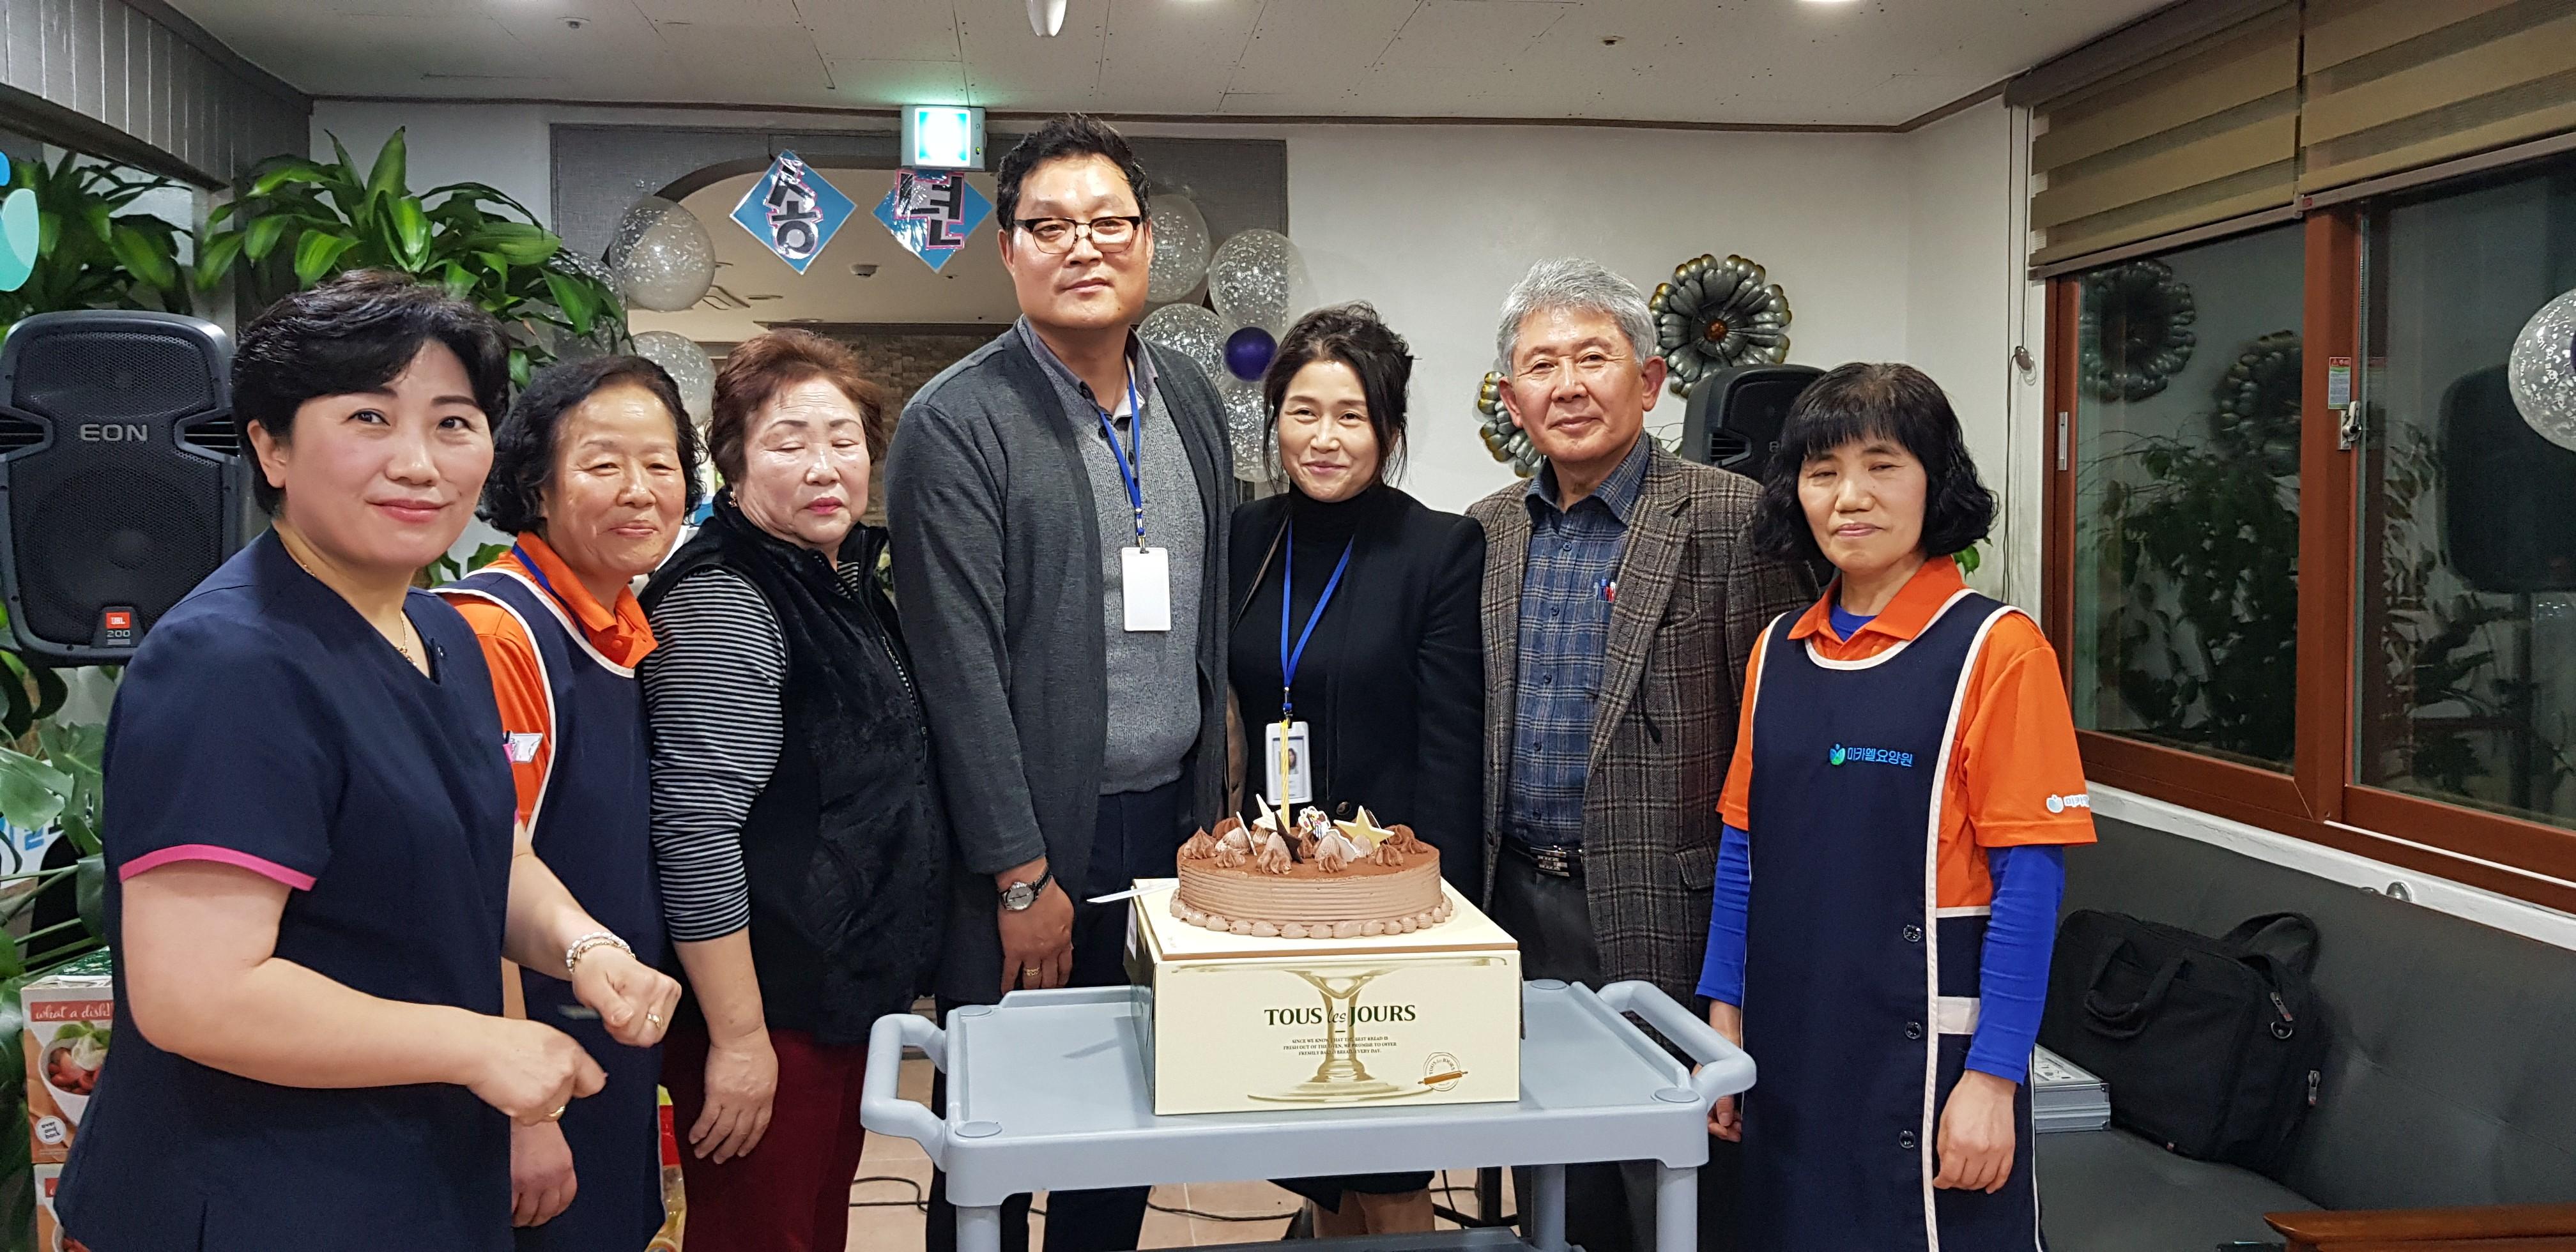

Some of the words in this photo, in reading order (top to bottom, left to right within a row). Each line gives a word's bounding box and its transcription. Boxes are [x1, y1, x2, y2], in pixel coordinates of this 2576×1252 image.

[80, 424, 148, 442] EON
[111, 616, 125, 625] JBL
[1847, 747, 1912, 767] 미카엘요양원
[36, 1005, 67, 1019] what
[82, 1002, 111, 1018] dish!
[1264, 1007, 1322, 1025] TOUS
[1327, 1005, 1347, 1023] les
[1349, 1004, 1416, 1027] JOURS
